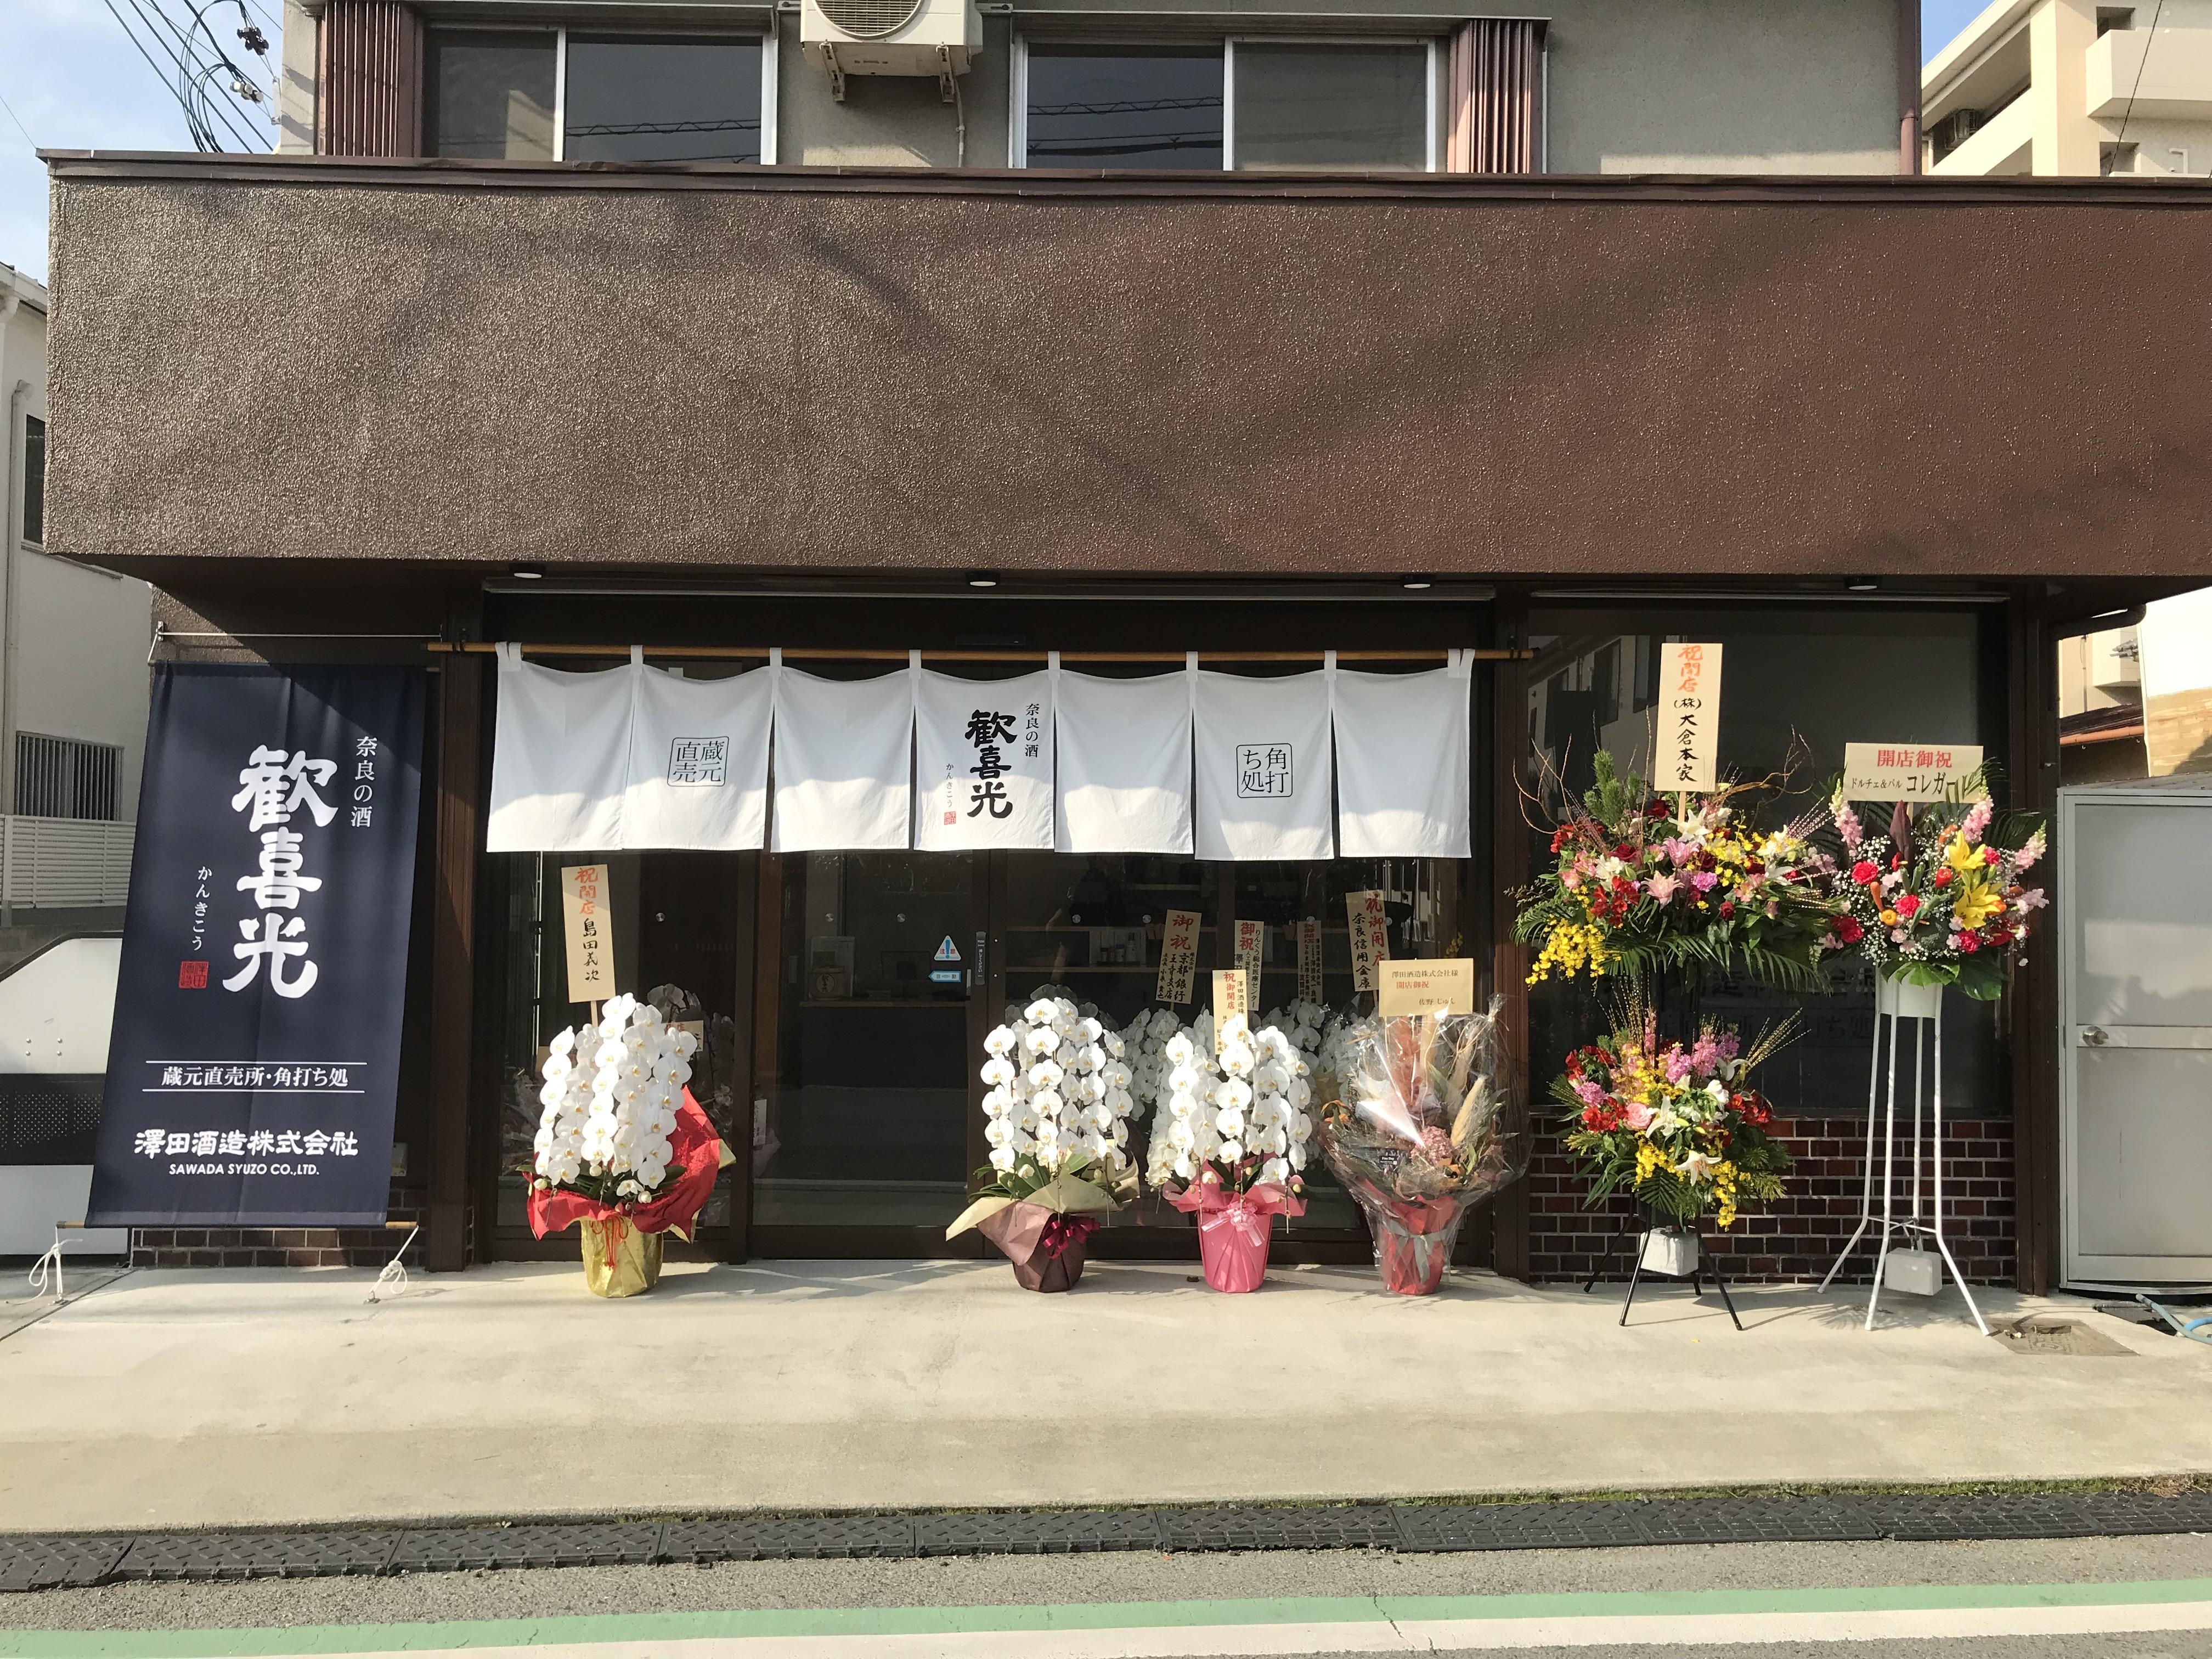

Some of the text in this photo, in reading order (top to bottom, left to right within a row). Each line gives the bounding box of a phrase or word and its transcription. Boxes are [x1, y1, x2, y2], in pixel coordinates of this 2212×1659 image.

[1678, 644, 1703, 693] 祝開店
[1025, 703, 1040, 758] 奈良の酒
[964, 709, 1018, 819] 歓喜光
[1877, 749, 1953, 768] 開店御祝
[350, 737, 378, 827] 奈良の酒
[946, 763, 954, 808] かんきこう
[223, 745, 338, 998] 歓喜光
[192, 866, 212, 951] かんきこう
[574, 867, 600, 983] 祝開店 島田義次
[1171, 915, 1194, 950] 御祝
[1239, 922, 1256, 951] 御祝
[1352, 913, 1372, 989] 奈良信用金庫
[1165, 954, 1177, 1000] 王寺支店
[1174, 953, 1189, 1001] 京都銀行
[1223, 972, 1237, 1009] 祝御開店
[1251, 929, 1261, 1008] りんくう総合医療センター
[1391, 969, 1458, 978] 澤田酒造株式会社様
[1396, 980, 1429, 989] 開店御祝
[161, 1066, 348, 1087] 蔵元直売所・角打ち処
[134, 1128, 359, 1159] 澤田酒造株式会社
[169, 1164, 320, 1176] SAWADA SYUZO CO.,LTD.
